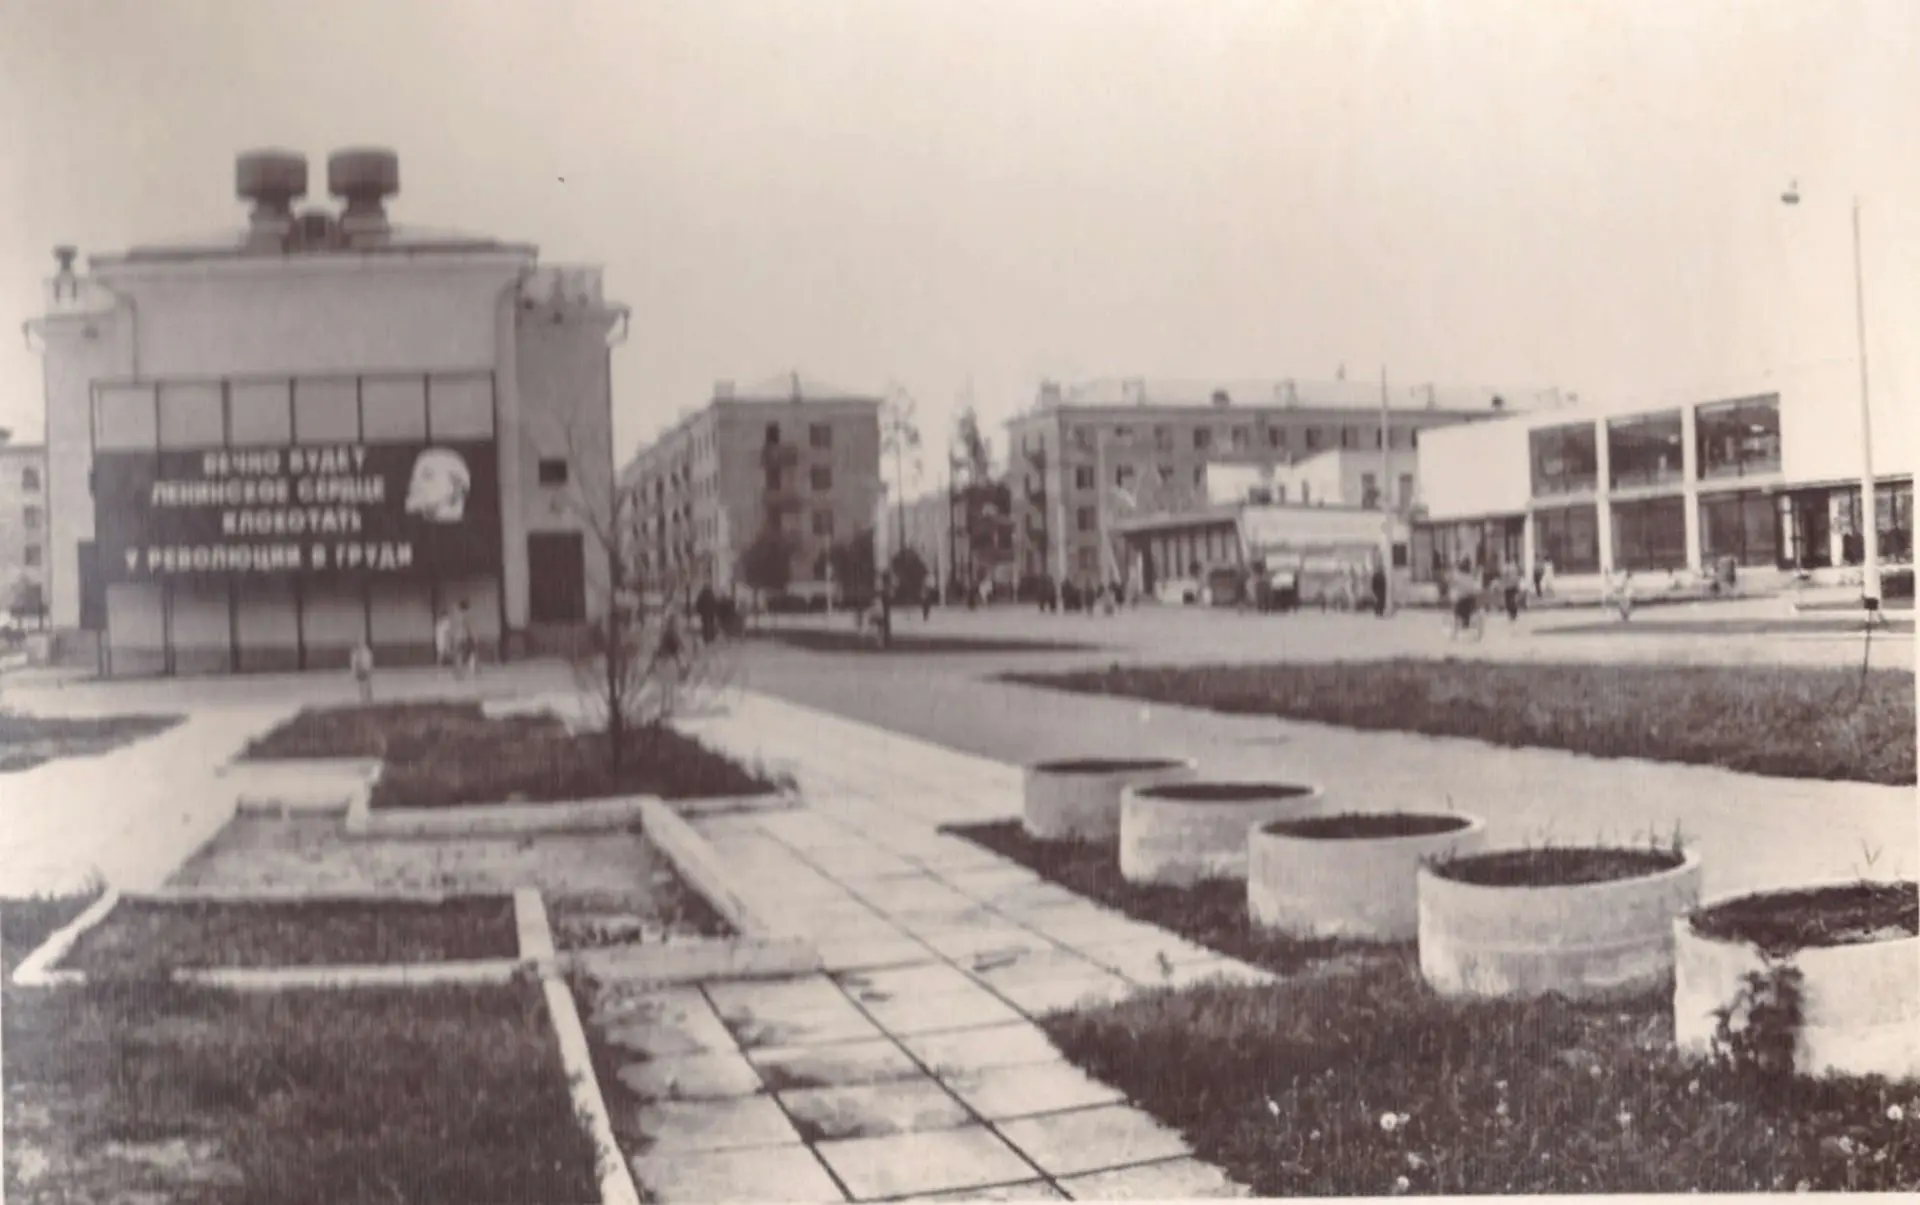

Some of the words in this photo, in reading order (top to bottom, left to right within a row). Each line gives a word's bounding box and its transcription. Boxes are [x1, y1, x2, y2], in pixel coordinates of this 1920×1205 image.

[203, 450, 280, 474] ВЕЧНО
[290, 447, 366, 473] БУДЕТ
[152, 479, 289, 504] ЛЕНИНСКОЕ
[298, 475, 385, 503] СЕРДЦЕ
[222, 508, 362, 534] КЛОКОТАТЬ
[125, 548, 139, 571] У
[147, 544, 301, 571] РЕВОЛЮЦИИ
[312, 544, 326, 570] В
[335, 542, 413, 571] ГРУДИ
